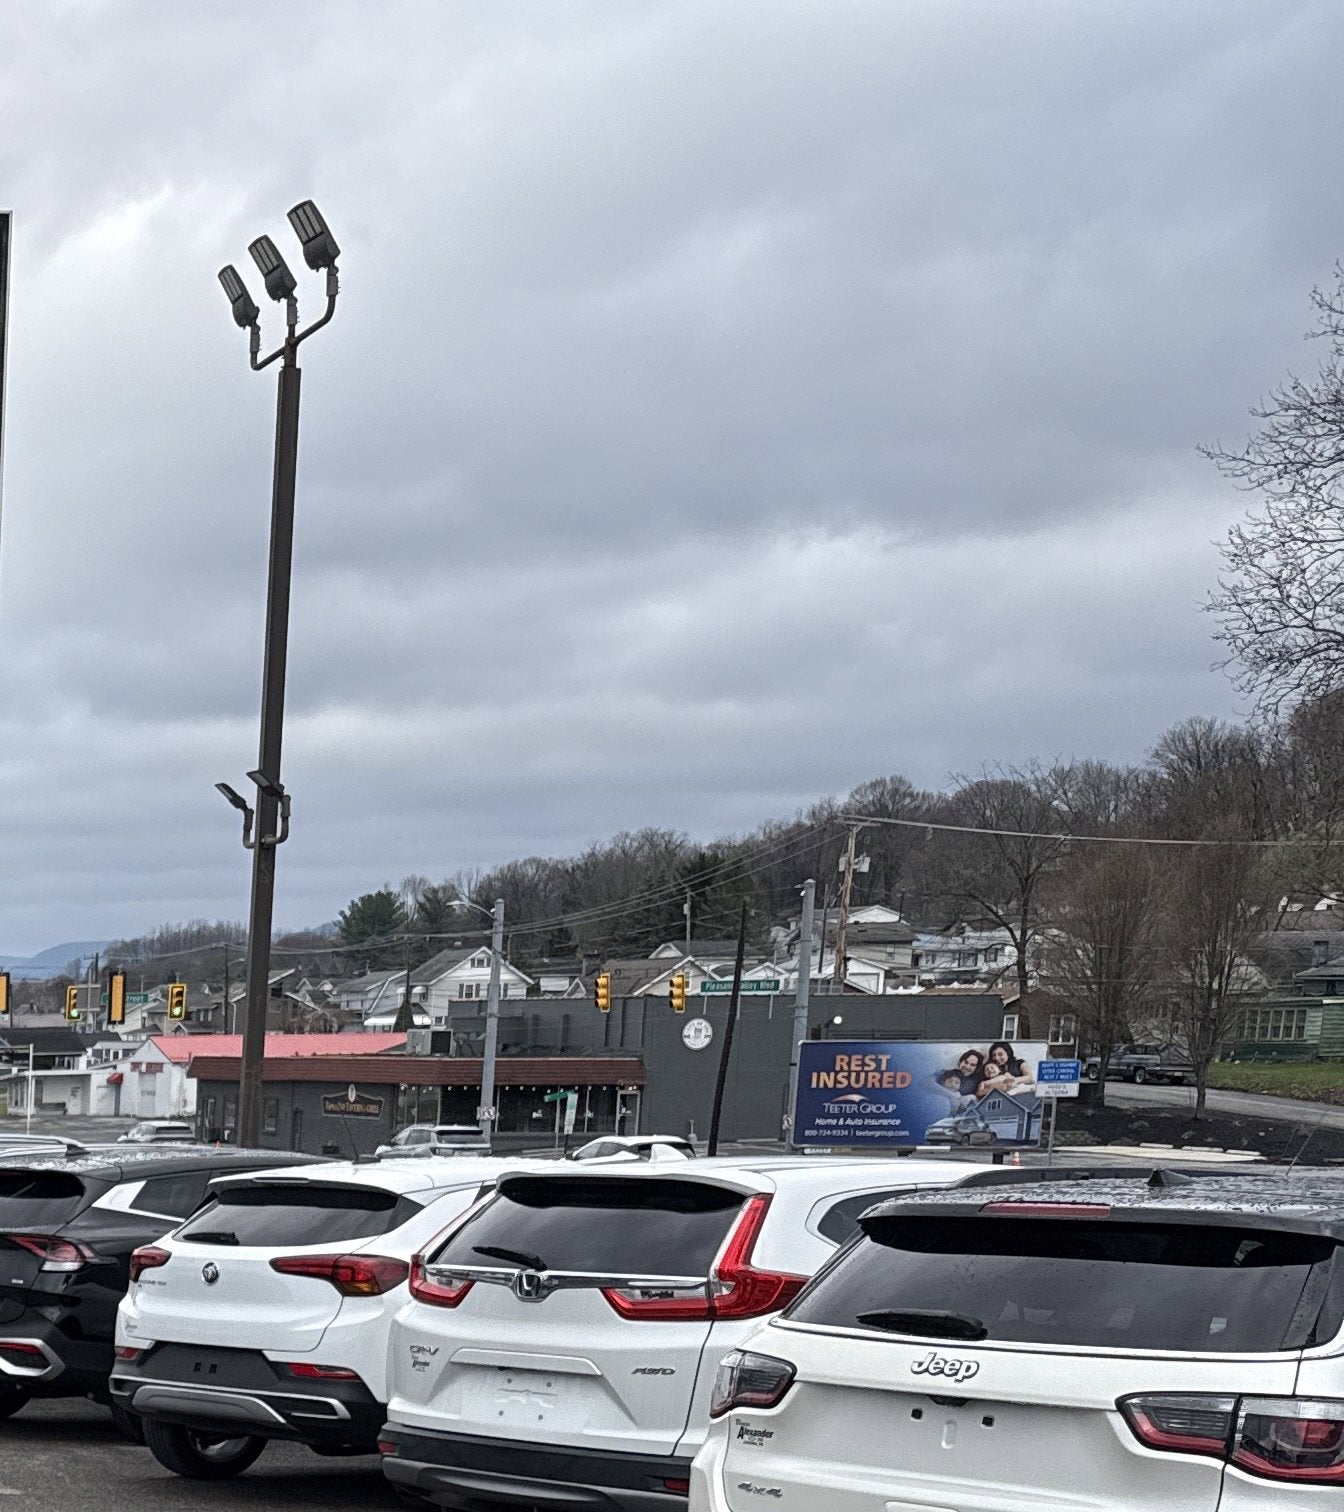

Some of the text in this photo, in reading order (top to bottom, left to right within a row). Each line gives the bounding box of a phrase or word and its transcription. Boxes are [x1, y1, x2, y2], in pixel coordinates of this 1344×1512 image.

[705, 981, 735, 991] Pleasan
[737, 981, 758, 991] alley
[835, 1054, 891, 1072] REST
[810, 1071, 913, 1089] INSURED
[822, 1102, 897, 1114] TEETER GROUP
[814, 1117, 902, 1126] Home & Auto Insurance
[631, 1367, 676, 1376] AWD
[910, 1351, 980, 1383] Jeep
[736, 1426, 775, 1439] Alexander
